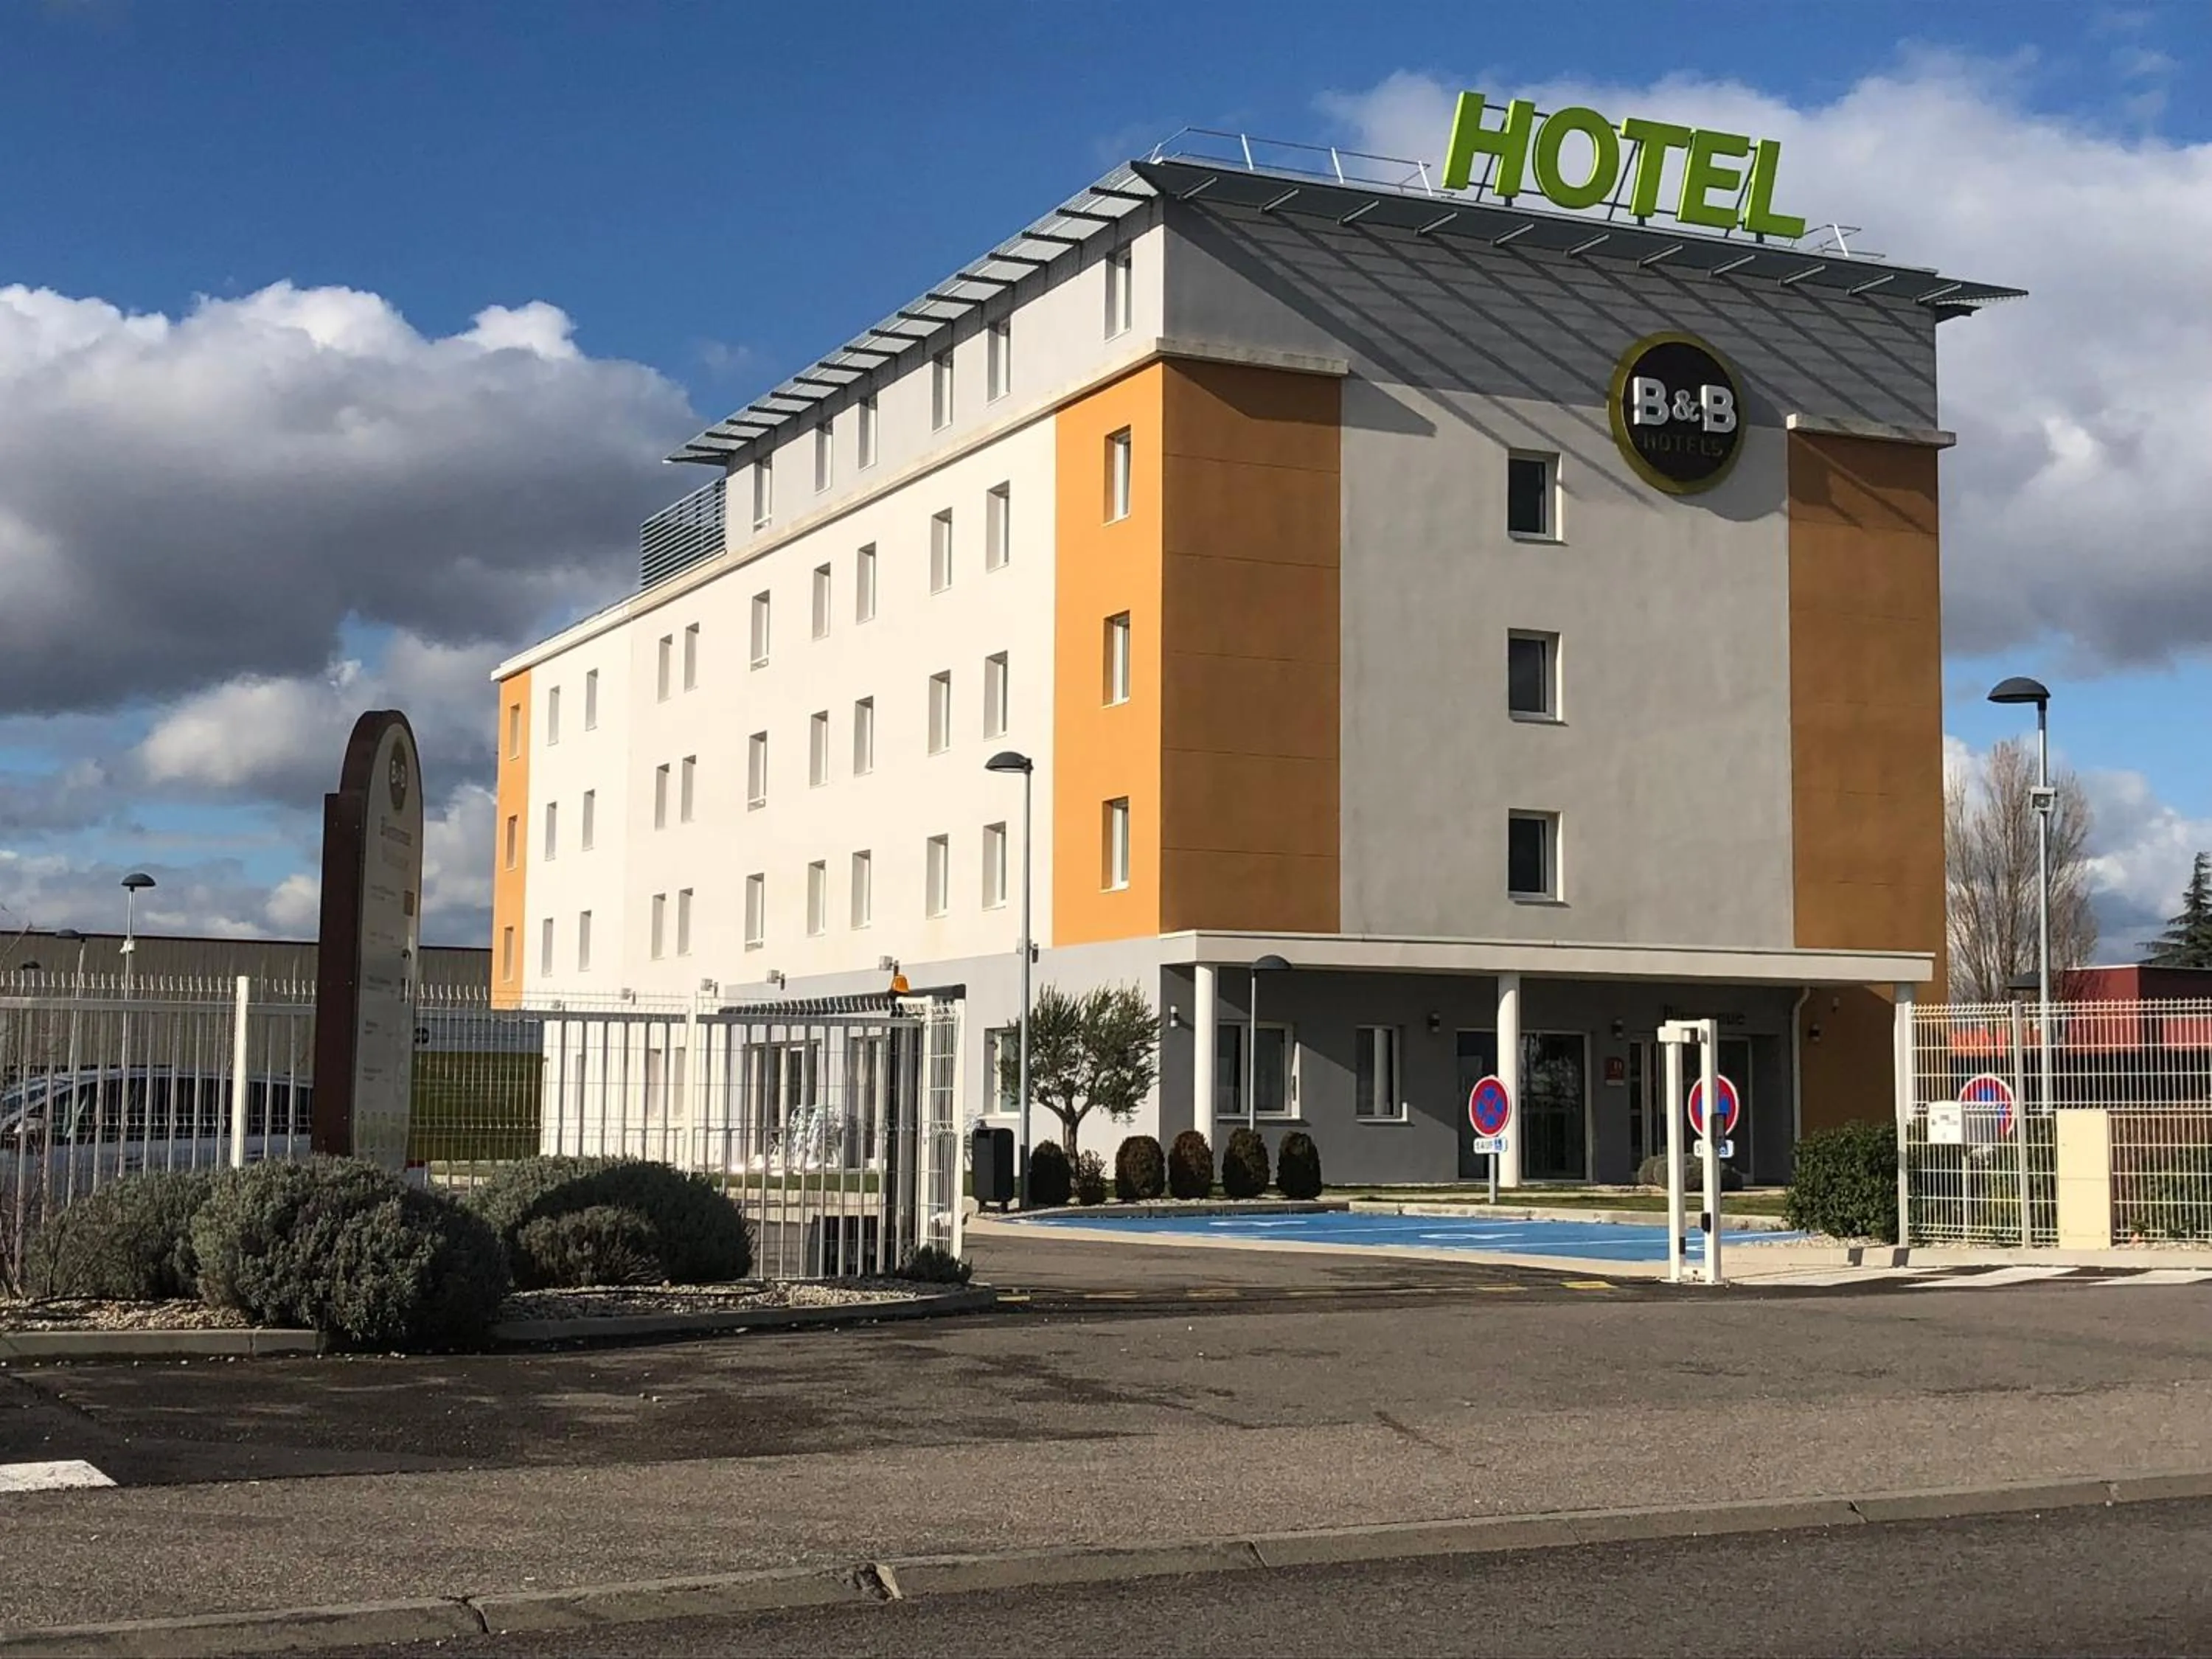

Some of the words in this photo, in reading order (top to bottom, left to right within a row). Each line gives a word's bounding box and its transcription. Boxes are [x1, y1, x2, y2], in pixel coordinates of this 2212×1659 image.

[1441, 91, 1806, 239] HOTEL
[1632, 376, 1737, 434] B&B
[1643, 434, 1723, 457] HOTELS
